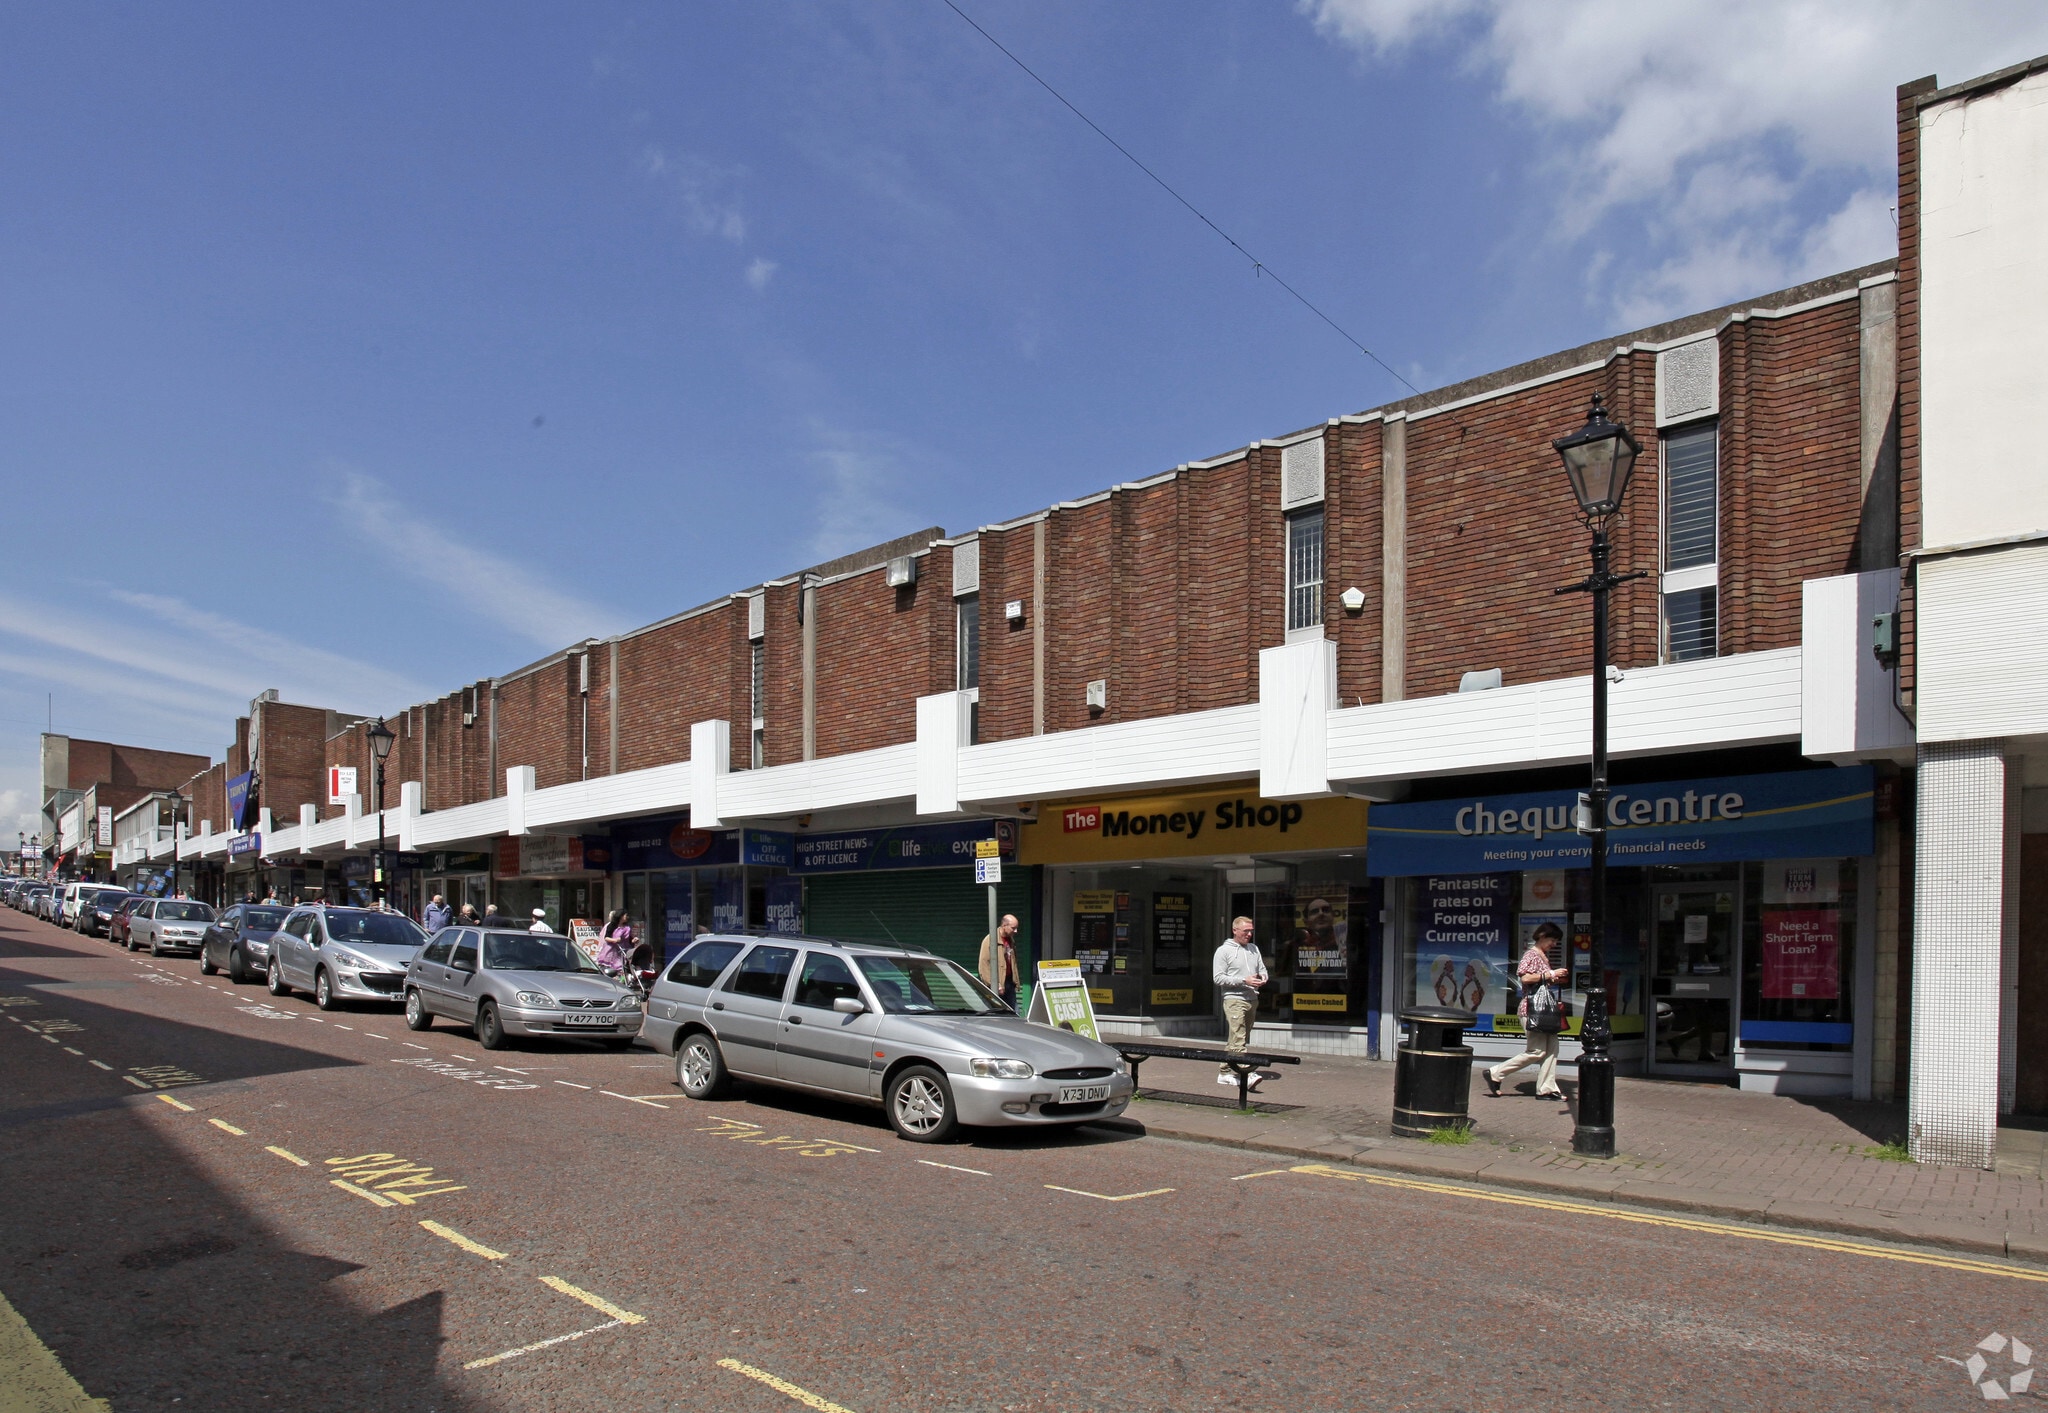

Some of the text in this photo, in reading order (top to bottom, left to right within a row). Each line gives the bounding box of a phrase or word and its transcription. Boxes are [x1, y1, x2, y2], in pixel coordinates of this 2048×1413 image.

[1607, 789, 1743, 826] Centre
[1066, 799, 1302, 839] The Money Shop
[762, 845, 777, 853] OFF
[796, 838, 867, 853] HIGH STREET NEWS
[1484, 849, 1527, 861] Meeting
[1531, 847, 1554, 860] your
[1614, 840, 1664, 854] financial
[1668, 838, 1706, 851] needs
[752, 854, 786, 864] LICENCE
[804, 852, 858, 866] & OFF LICENCE
[1428, 876, 1498, 891] Fantastic
[714, 902, 738, 917] motor
[1433, 896, 1492, 908] rates on
[767, 901, 794, 922] great
[1434, 911, 1491, 927] Foreign
[1780, 921, 1810, 930] Need
[1425, 929, 1499, 945] Currency!
[1765, 933, 1833, 943] Short Term
[1298, 950, 1340, 959] MAKE TODAY
[1781, 944, 1817, 954] Loan?
[1298, 959, 1343, 967] YOUR PAYDAY
[1322, 998, 1344, 1006] Cashed
[1054, 1002, 1086, 1021] CASH
[390, 1058, 540, 1090] DISABLED
[1063, 1087, 1106, 1101] X731 DNV
[693, 1123, 857, 1157] TAXIS
[324, 1153, 468, 1206] TAXIS
